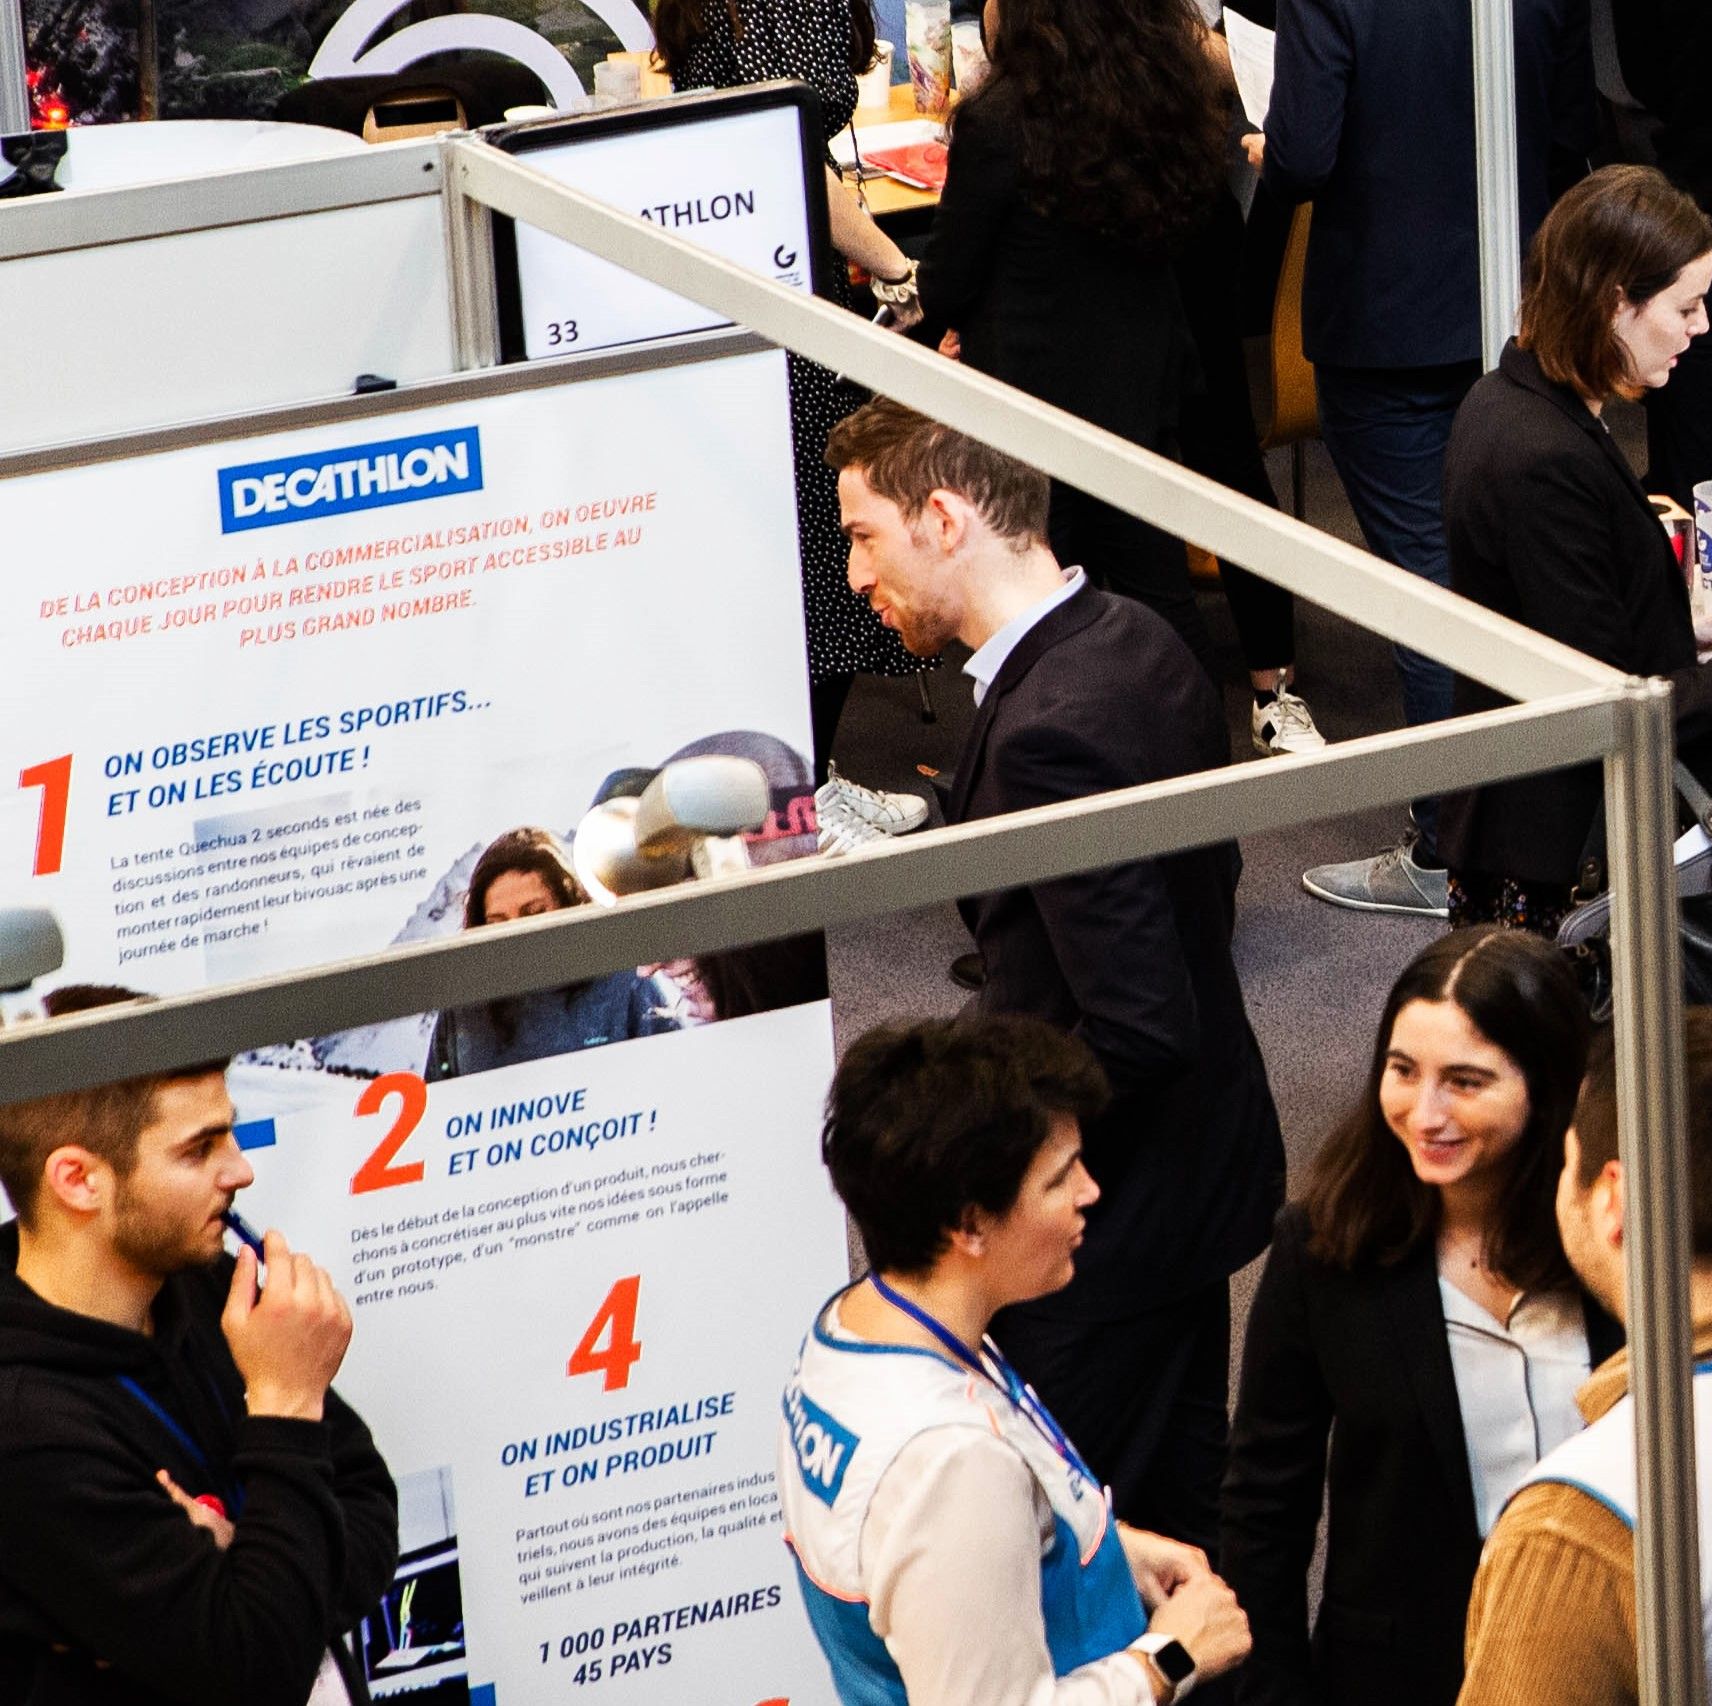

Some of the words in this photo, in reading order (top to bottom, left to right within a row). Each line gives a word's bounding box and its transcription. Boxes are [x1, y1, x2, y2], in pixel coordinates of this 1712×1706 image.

[547, 320, 579, 346] 33
[231, 442, 469, 518] DECATHLON
[40, 597, 69, 619] DE
[74, 591, 101, 613] LA
[108, 564, 247, 607] CONCEPTION
[252, 557, 267, 581] À
[272, 555, 299, 576] LA
[305, 515, 534, 571] COMMERCIALISATION,
[540, 507, 570, 529] ON
[575, 491, 658, 524] OEUVRE
[61, 615, 153, 649] CHAQUE
[159, 603, 217, 631] JOUR
[222, 589, 284, 620] POUR
[289, 573, 381, 607] RENDRE
[379, 568, 403, 592] LE
[409, 554, 479, 586] SPORT
[483, 531, 609, 573] ACCESSIBLE
[613, 526, 642, 547] AU
[239, 620, 297, 649] PLUS
[302, 606, 376, 638] GRAND
[105, 750, 143, 778] ON
[152, 724, 277, 769] OBSERVE
[282, 716, 330, 748] LES
[106, 791, 140, 818] ET
[148, 779, 187, 809] ON
[194, 769, 243, 802] LES
[251, 746, 356, 792] ÉCOUTE
[18, 752, 73, 878] 1
[110, 855, 129, 870] La
[134, 847, 175, 866] tente
[179, 832, 247, 857] Quechua
[251, 828, 262, 843] 2
[266, 815, 330, 840] seconds
[335, 811, 358, 827] est
[363, 802, 390, 821] née
[395, 799, 422, 814] des
[112, 864, 205, 892] discussions
[208, 858, 248, 874] entre
[250, 850, 277, 865] nos
[280, 838, 340, 860] équipes
[343, 833, 361, 848] de
[364, 823, 424, 845] concep-
[115, 900, 144, 916] tion
[151, 895, 165, 908] et
[172, 889, 199, 905] des
[205, 868, 306, 899] randonneurs,
[311, 862, 335, 879] qui
[407, 843, 425, 858] de
[116, 916, 172, 939] monter
[174, 898, 260, 929] rapidement
[263, 891, 291, 909] leur
[293, 880, 354, 902] bivouac
[400, 867, 428, 882] une
[118, 938, 177, 967] journée
[181, 934, 200, 949] de
[203, 922, 261, 945] marche
[350, 1069, 428, 1196] 2
[446, 1111, 483, 1139] ON
[490, 1087, 589, 1130] INNOVE
[448, 1148, 480, 1176] ET
[487, 1139, 524, 1167] ON
[530, 1112, 644, 1157] CONÇOIT
[351, 1226, 379, 1244] Dès
[381, 1222, 395, 1237] le
[397, 1213, 440, 1234] début
[442, 1208, 460, 1223] de
[462, 1204, 476, 1219] la
[478, 1186, 559, 1215] conception
[594, 1167, 650, 1192] produit,
[651, 1160, 688, 1175] nous
[689, 1151, 727, 1169] cher-
[352, 1244, 398, 1265] chons
[401, 1238, 410, 1253] à
[411, 1222, 493, 1251] concrétiser
[496, 1217, 514, 1232] au
[516, 1208, 547, 1231] plus
[550, 1201, 576, 1219] vite
[579, 1198, 605, 1213] nos
[606, 1189, 646, 1208] idées
[649, 1180, 683, 1198] sous
[685, 1170, 728, 1191] forme
[391, 1250, 468, 1280] prototype,
[586, 1211, 641, 1233] comme
[645, 1206, 665, 1219] on
[355, 1287, 394, 1306] entre
[566, 1273, 643, 1394] 4
[501, 1438, 538, 1467] ON
[545, 1391, 737, 1456] INDUSTRIALISE
[524, 1469, 556, 1498] ET
[562, 1459, 599, 1488] ON
[605, 1431, 718, 1478] PRODUIT
[516, 1519, 569, 1542] Partout
[592, 1506, 623, 1524] sont
[625, 1500, 651, 1516] nos
[653, 1481, 734, 1511] partenaires
[737, 1471, 776, 1490] indus
[517, 1544, 558, 1564] triels,
[559, 1535, 594, 1553] nous
[597, 1525, 640, 1544] avons
[642, 1518, 668, 1533] des
[670, 1503, 726, 1526] équipes
[729, 1499, 746, 1512] en
[748, 1491, 779, 1507] loca
[518, 1570, 541, 1585] qui
[545, 1555, 596, 1578] suivent
[600, 1550, 613, 1564] la
[617, 1531, 698, 1561] production,
[701, 1526, 714, 1540] la
[718, 1512, 766, 1537] qualité
[769, 1508, 783, 1523] et
[520, 1581, 572, 1605] veillent
[576, 1578, 585, 1590] à
[588, 1571, 615, 1588] leur
[538, 1640, 551, 1665] 1
[560, 1626, 605, 1659] 000
[611, 1584, 783, 1645] PARTENAIRES
[572, 1659, 603, 1686] 45
[610, 1642, 673, 1677] PAYS
